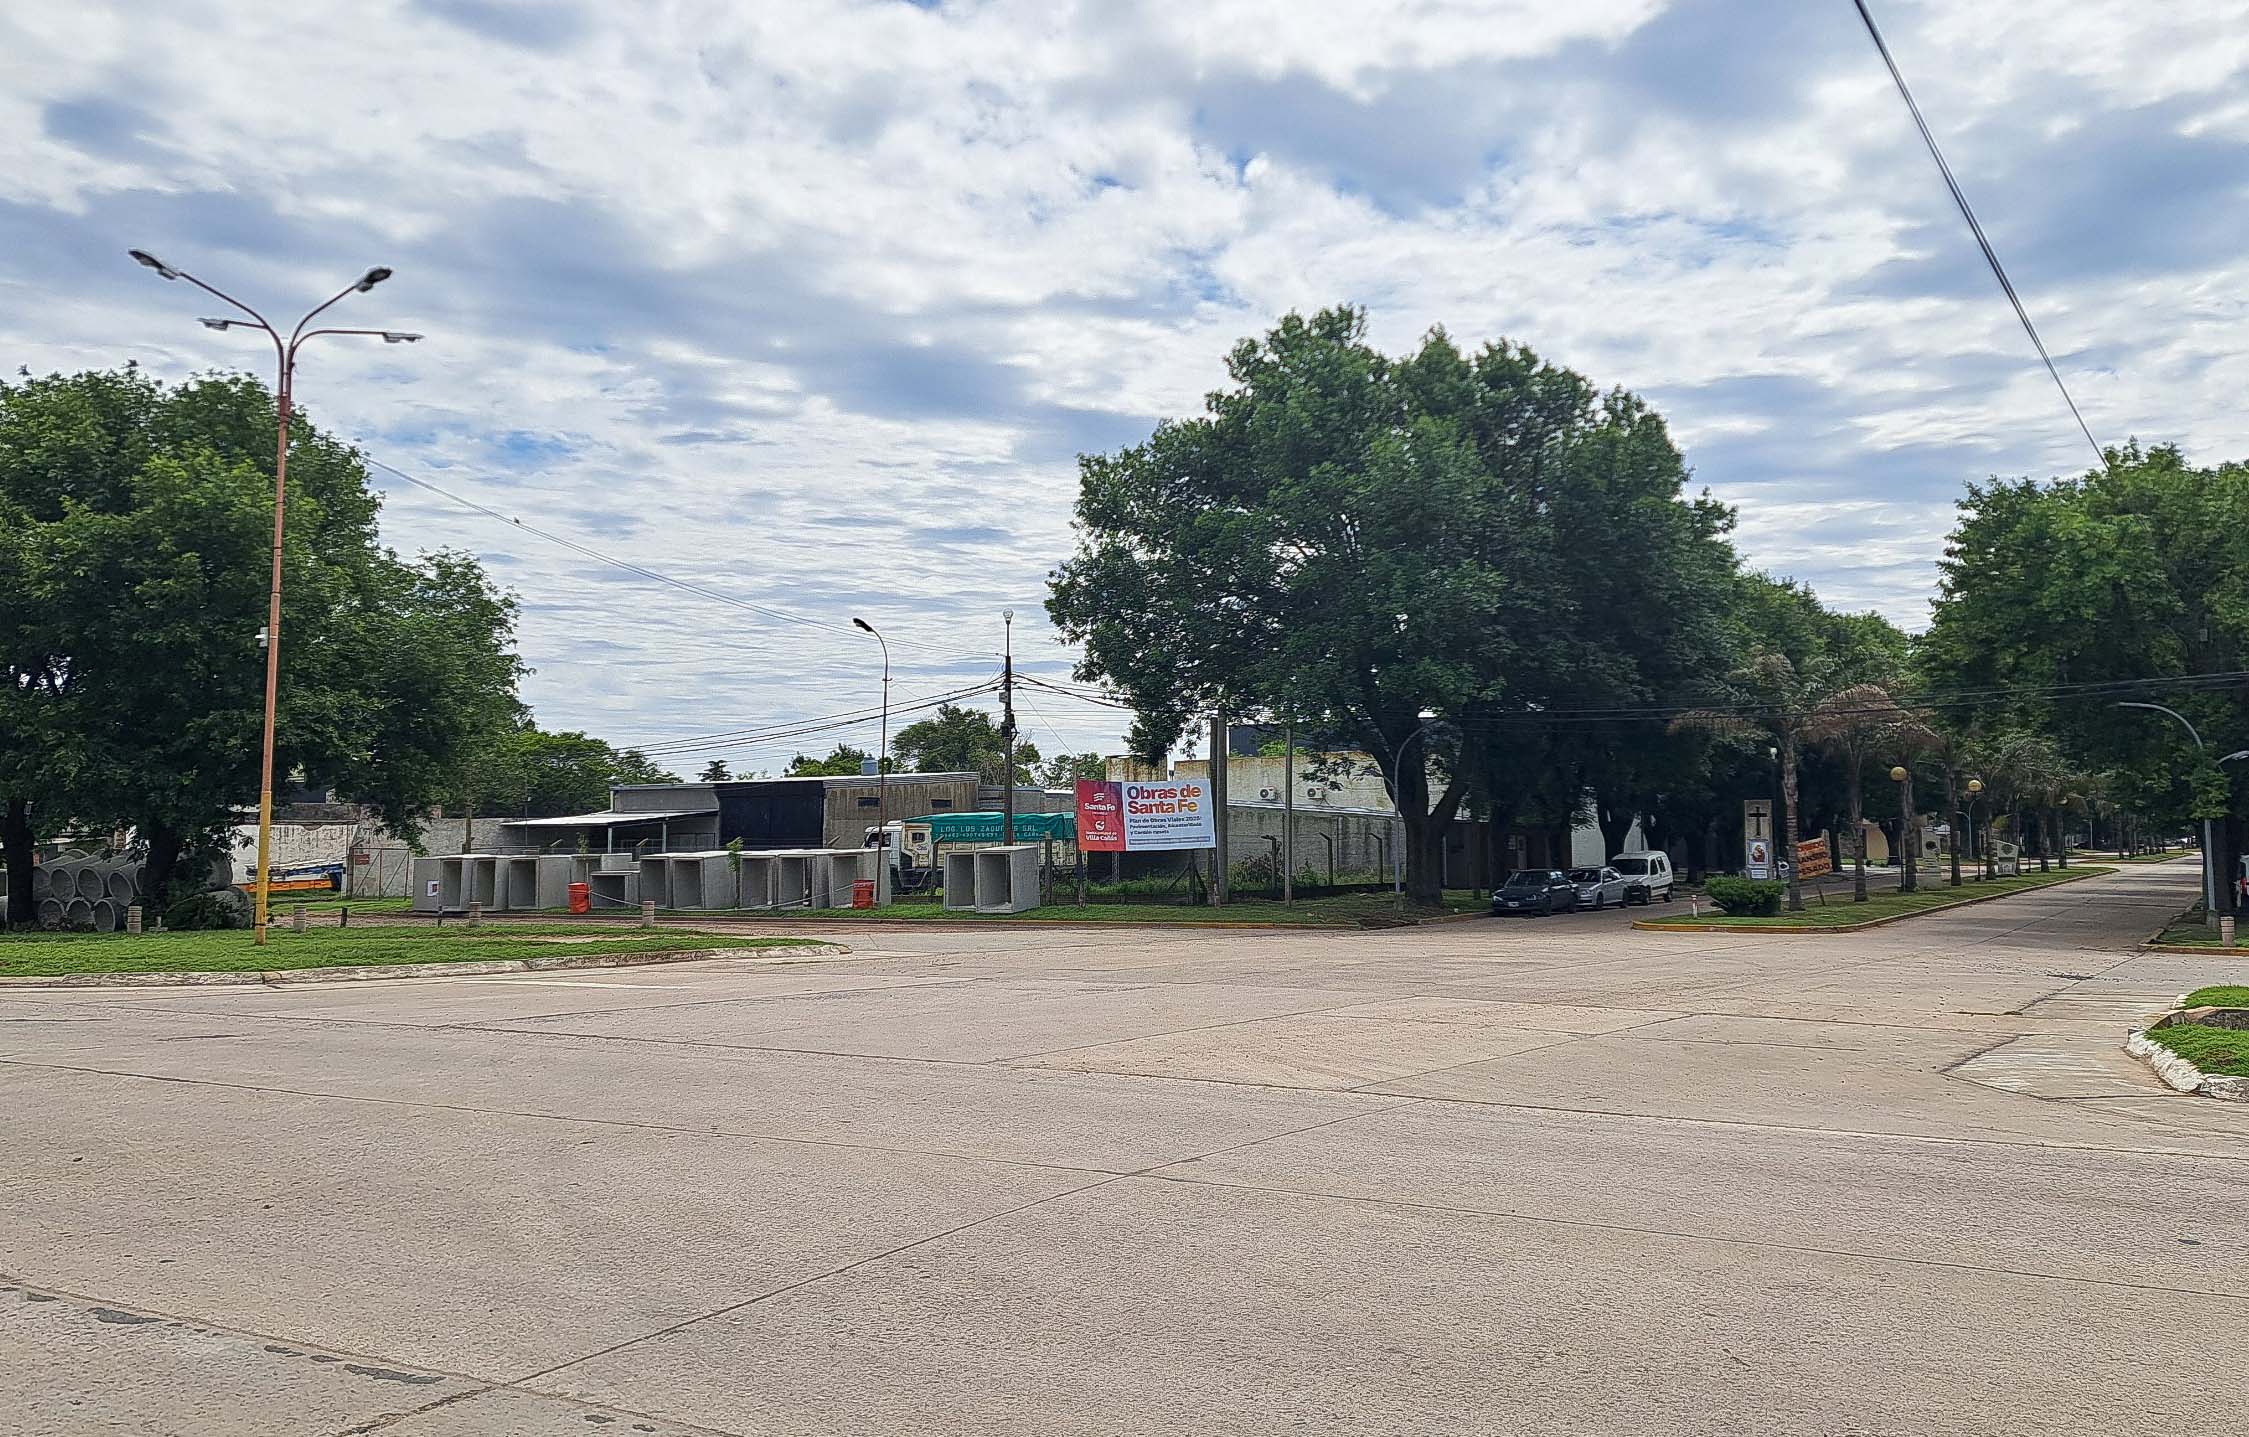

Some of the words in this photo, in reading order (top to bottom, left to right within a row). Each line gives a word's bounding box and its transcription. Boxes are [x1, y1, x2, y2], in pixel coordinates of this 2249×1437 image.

[1127, 785, 1178, 800] Obras
[1180, 784, 1201, 798] de
[1084, 803, 1106, 811] Santa
[1127, 801, 1175, 815] Santa
[1178, 799, 1198, 813] Fe
[960, 825, 976, 833] LOS
